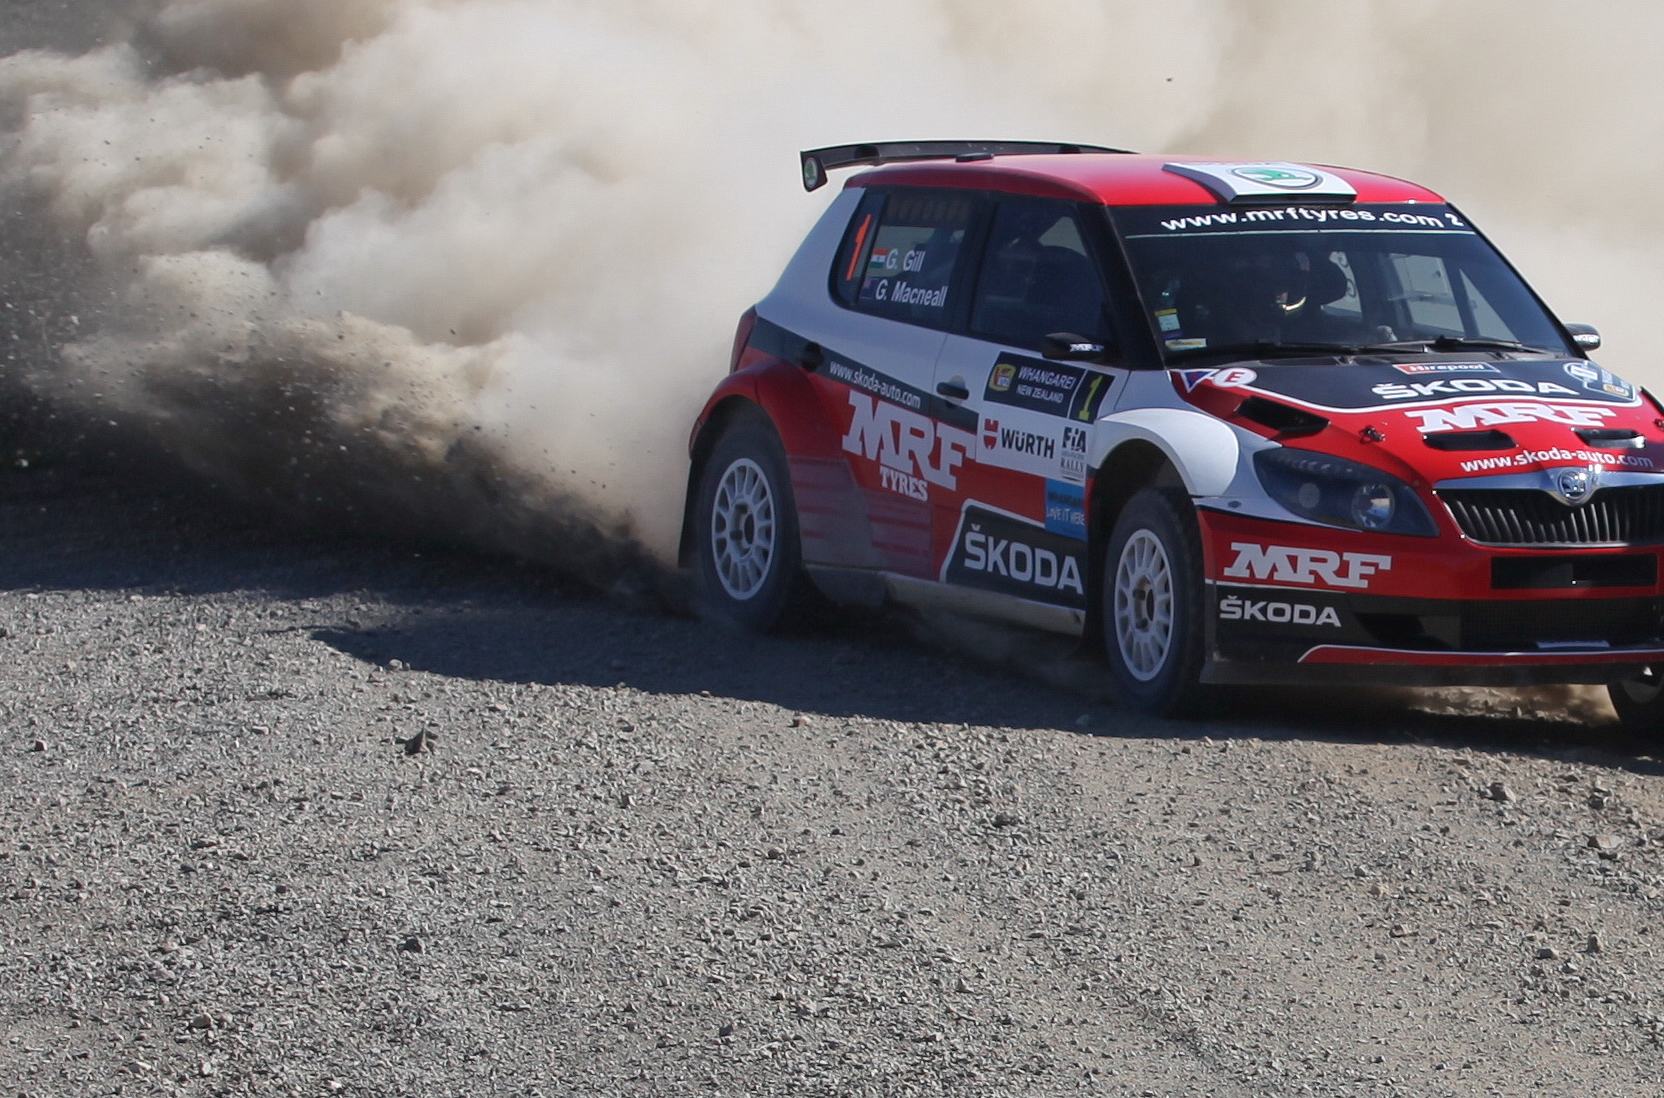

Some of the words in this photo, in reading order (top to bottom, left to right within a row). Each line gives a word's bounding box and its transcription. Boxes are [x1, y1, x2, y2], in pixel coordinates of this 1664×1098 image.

[1161, 207, 1444, 231] www.mrftyres.com
[846, 214, 873, 281] 1
[886, 249, 899, 270] G.
[903, 251, 926, 272] Gill
[875, 279, 887, 300] G.
[891, 281, 948, 307] Macneall
[829, 361, 922, 409] www.skoda-auto.com
[1018, 365, 1077, 390] WHANGAREI
[1371, 379, 1580, 399] ŠKODA
[1016, 384, 1032, 398] NEW
[1032, 388, 1064, 404] ZEALAND
[1078, 374, 1103, 421] 1
[1404, 402, 1617, 433] MRF
[842, 389, 977, 491] MRF
[1001, 427, 1055, 459] WÜRTH
[1060, 456, 1084, 473] RALLY
[1460, 447, 1655, 472] www.skoda-auto.com
[880, 465, 928, 501] TYRES
[964, 523, 1084, 595] ŠKODA
[1223, 542, 1392, 588] MRF
[1219, 595, 1342, 627] ŠKODA
